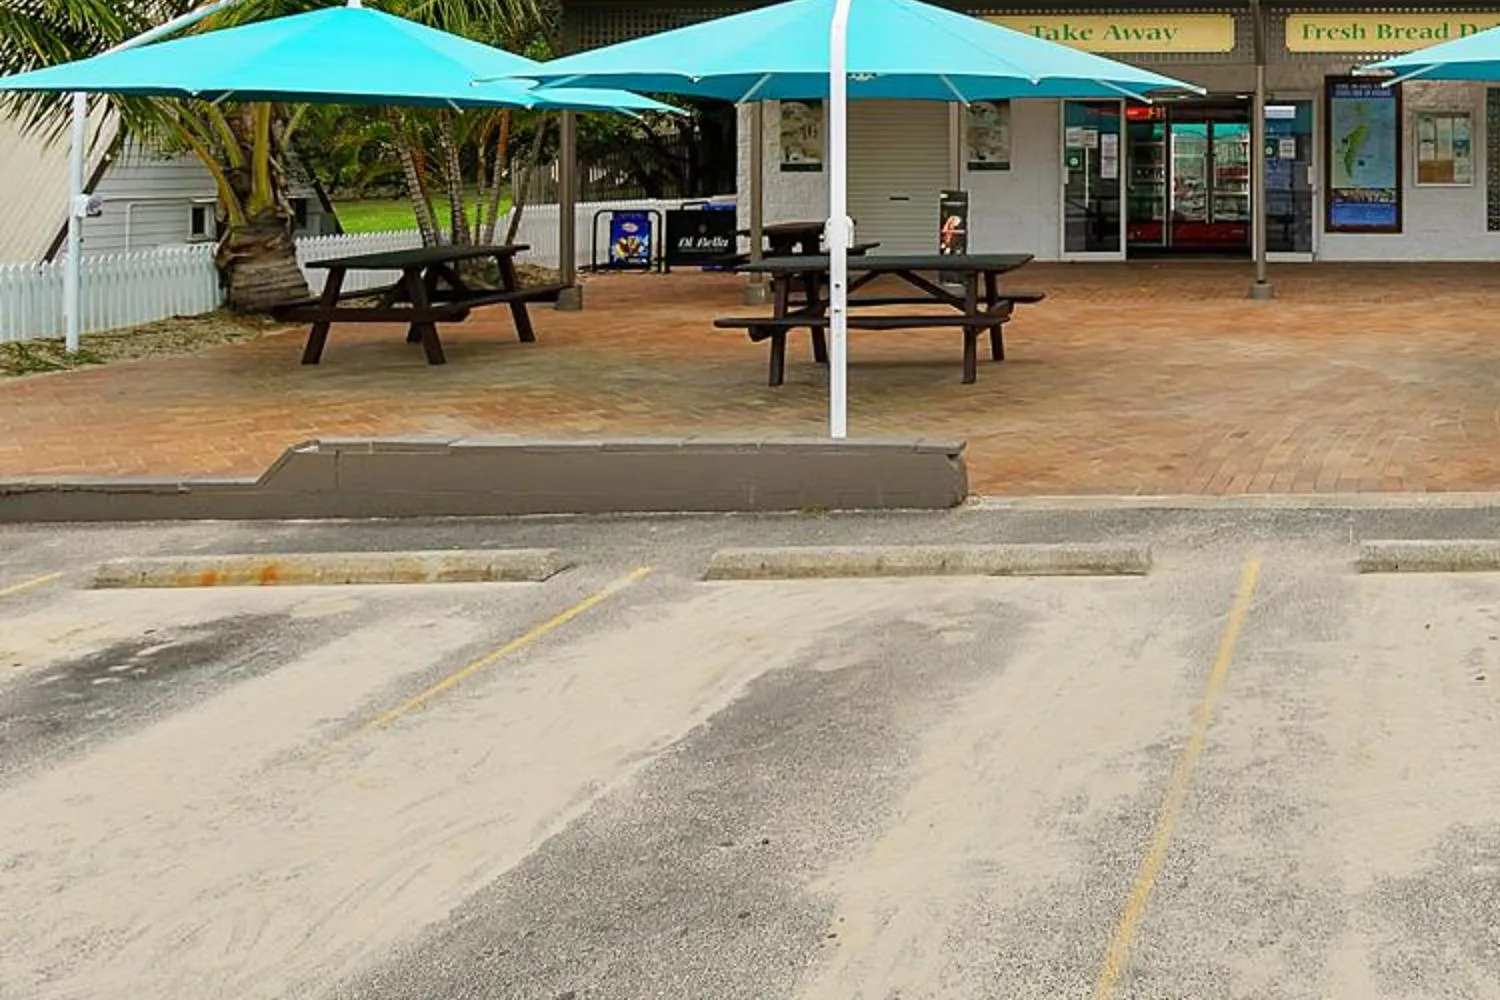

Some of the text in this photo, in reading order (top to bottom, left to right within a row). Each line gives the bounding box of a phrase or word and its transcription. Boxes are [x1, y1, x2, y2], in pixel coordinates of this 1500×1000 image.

[1029, 23, 1178, 46] Take Away
[1302, 22, 1366, 41] Fresh
[1376, 22, 1449, 41] Bread
